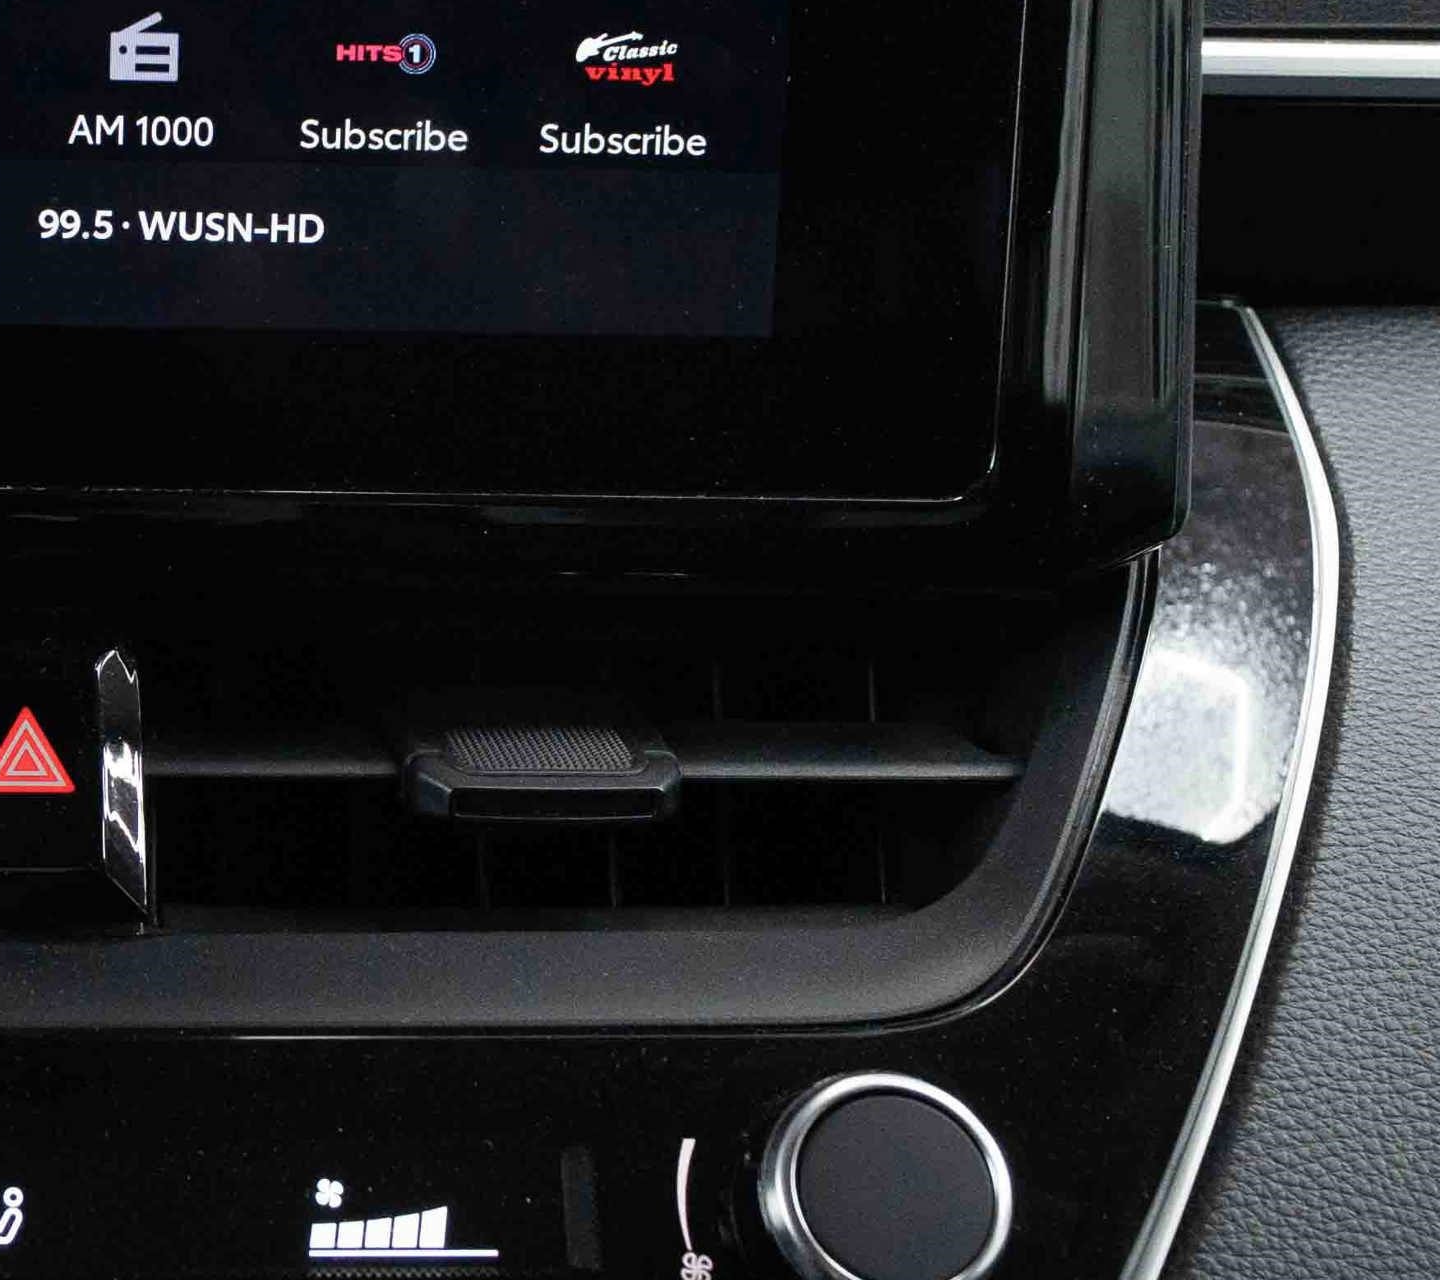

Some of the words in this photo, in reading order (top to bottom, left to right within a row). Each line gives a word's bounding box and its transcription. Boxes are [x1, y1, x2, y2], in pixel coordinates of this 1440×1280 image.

[336, 43, 403, 63] HITS
[407, 43, 422, 64] 1
[602, 39, 678, 63] Classic
[584, 63, 675, 87] vinyl
[67, 114, 125, 146] AM
[135, 115, 214, 147] 1000
[299, 117, 469, 152] Subscribe
[539, 122, 707, 156] Subscribe
[37, 208, 114, 240] 99.5
[137, 210, 325, 244] WUSN-HD
